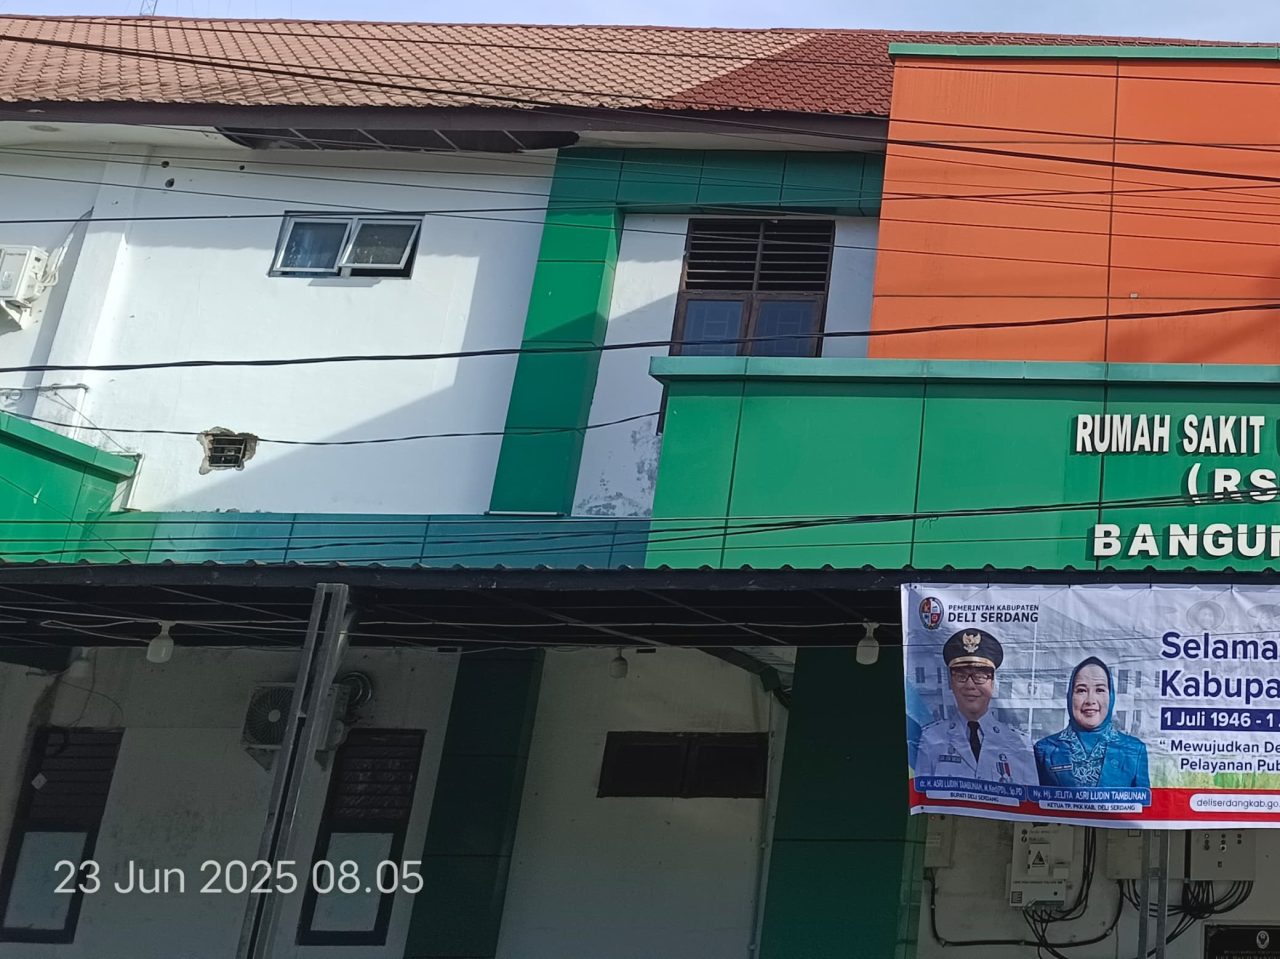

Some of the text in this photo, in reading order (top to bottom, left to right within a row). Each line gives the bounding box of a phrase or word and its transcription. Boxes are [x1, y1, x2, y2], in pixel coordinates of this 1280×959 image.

[1076, 414, 1171, 454] RUMAH
[1183, 415, 1266, 454] SAKIT
[948, 612, 1039, 623] DELI SERDANG
[1163, 712, 1171, 726] 1
[1176, 712, 1205, 727] Juli
[1210, 712, 1251, 727] 1946
[1265, 713, 1274, 727] 1
[1170, 740, 1259, 754] Mewujudkan
[1180, 758, 1252, 773] Pelayanan
[1054, 791, 1073, 799] JELITA
[1075, 791, 1089, 800] ASRI
[1090, 791, 1110, 800] LUDIN
[1111, 792, 1147, 800] TAMBUNAN
